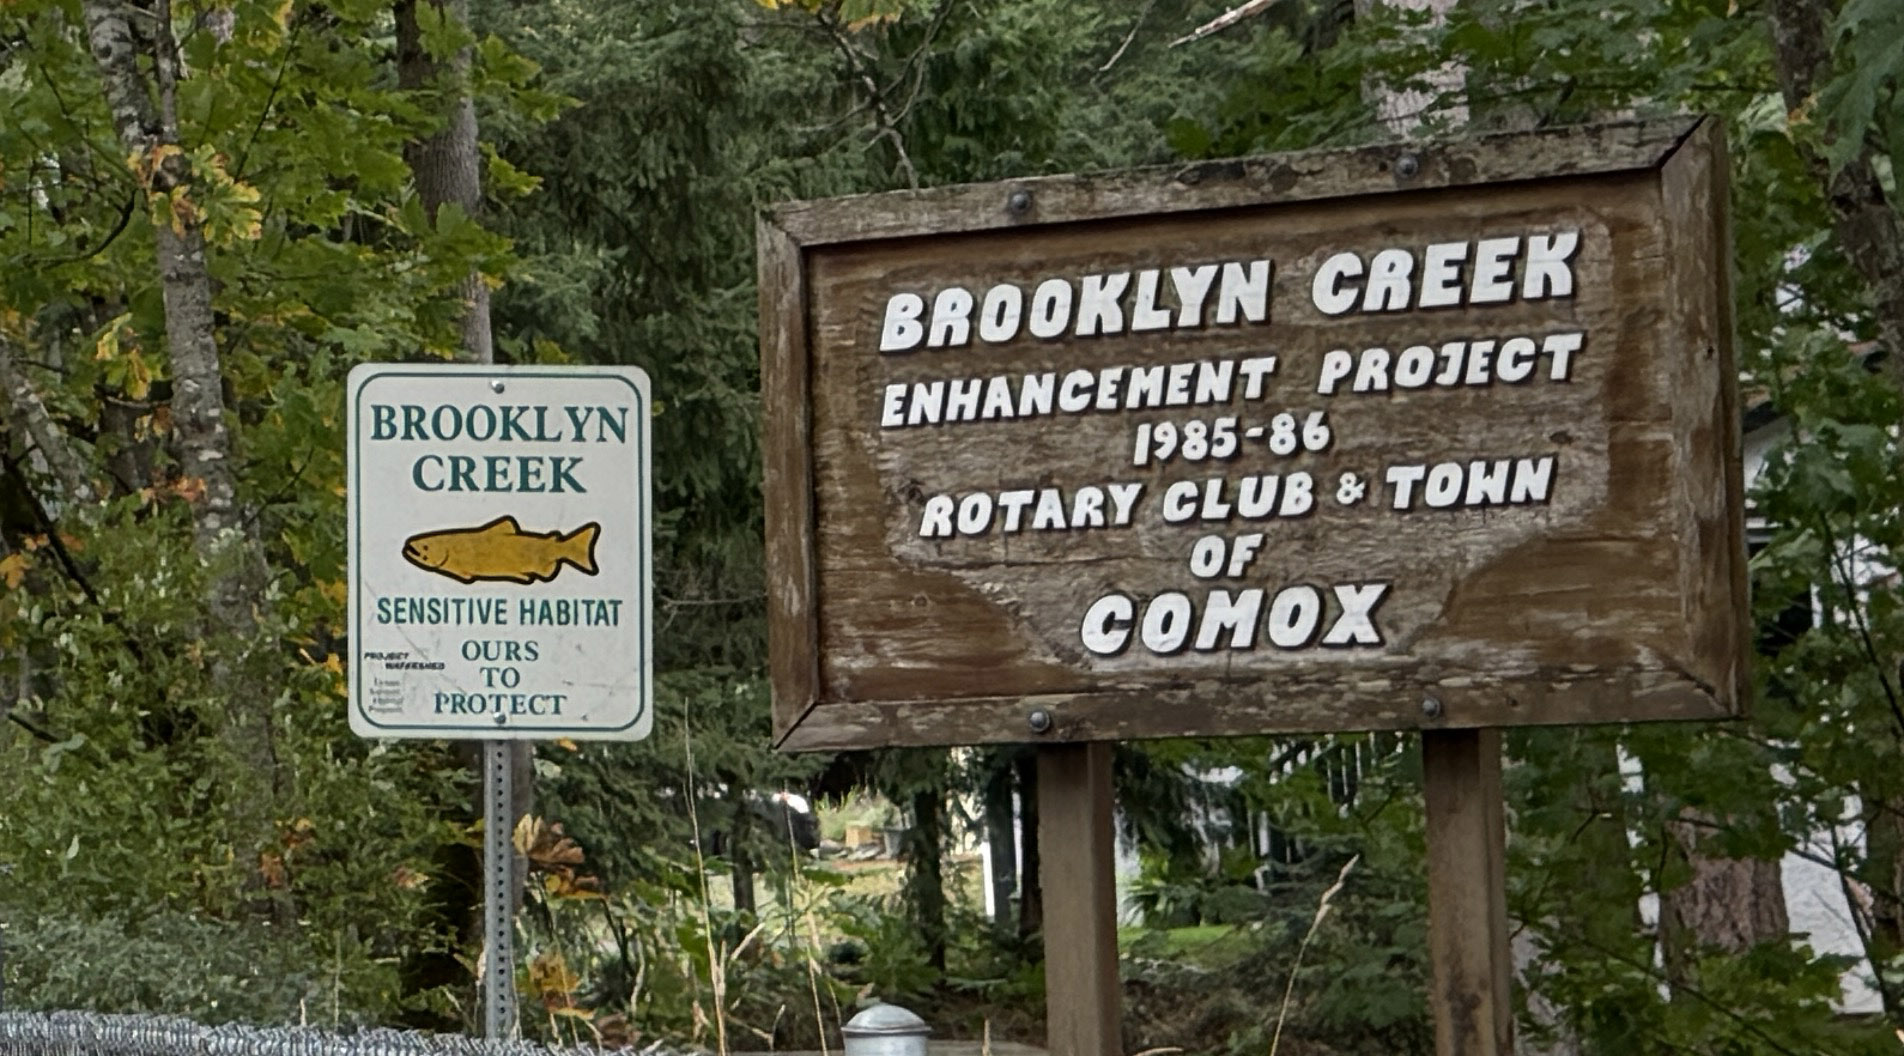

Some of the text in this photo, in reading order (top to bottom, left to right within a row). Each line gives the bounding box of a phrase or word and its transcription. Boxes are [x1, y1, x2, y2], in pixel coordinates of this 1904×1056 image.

[879, 232, 1578, 351] BROOKLYN CREEK
[881, 333, 1582, 428] ENHANCEMENT PROJECT
[370, 404, 629, 444] BROOKLYN
[1133, 411, 1330, 465] 1985-86
[412, 454, 588, 494] CREEK
[919, 458, 1553, 537] ROTARY CLUB & TOWN
[1190, 533, 1263, 577] OF
[377, 597, 624, 627] SENSITIVE HABITAT
[1081, 584, 1386, 658] COMOX
[461, 640, 539, 662] OURS
[479, 666, 521, 689] TO
[434, 691, 568, 716] PROTECT
